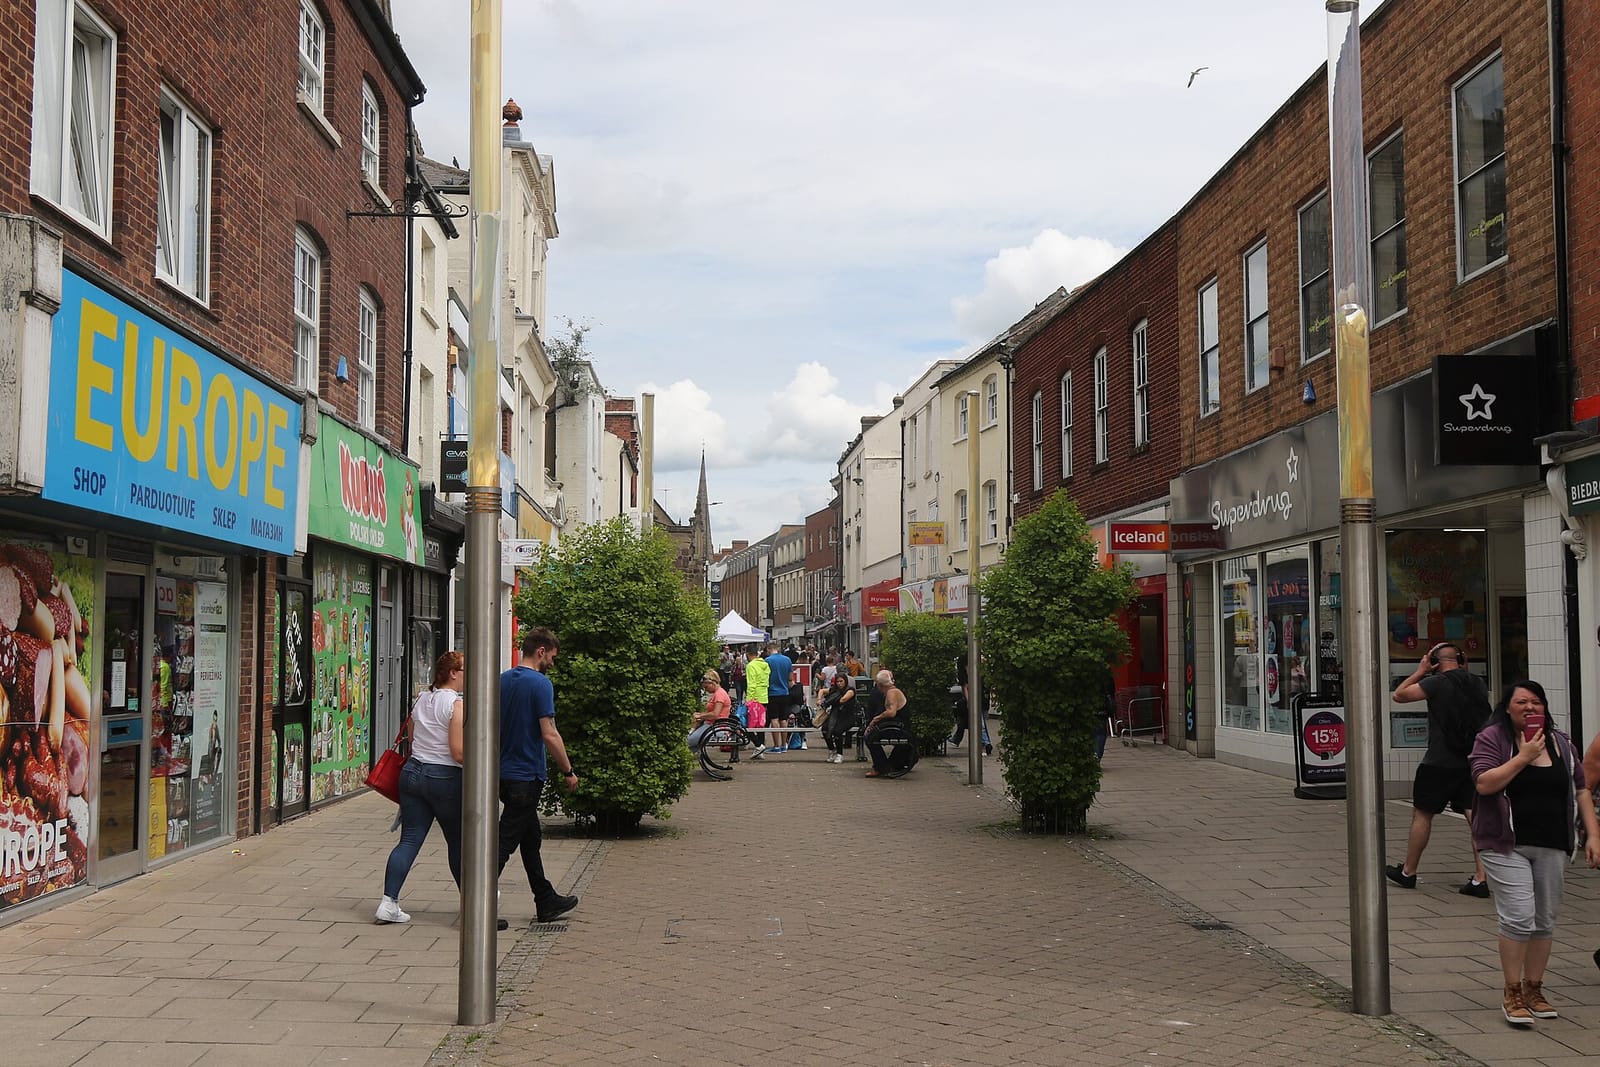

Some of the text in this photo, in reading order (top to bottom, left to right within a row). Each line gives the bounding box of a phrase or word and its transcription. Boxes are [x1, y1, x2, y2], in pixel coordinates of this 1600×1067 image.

[74, 297, 289, 510] EUROPE
[1443, 423, 1513, 434] Superdrug
[73, 466, 237, 530] SHOP PARDUOTUVE SKLEP
[1571, 479, 1600, 501] BIEDR
[1211, 490, 1293, 533] Superdrug
[251, 518, 284, 543] МАГАЗИН
[1115, 530, 1165, 543] Iceland
[1320, 594, 1338, 606] BEAUTY
[292, 610, 303, 646] OFF
[1311, 728, 1339, 744] 15%
[0, 818, 68, 878] ROPE
